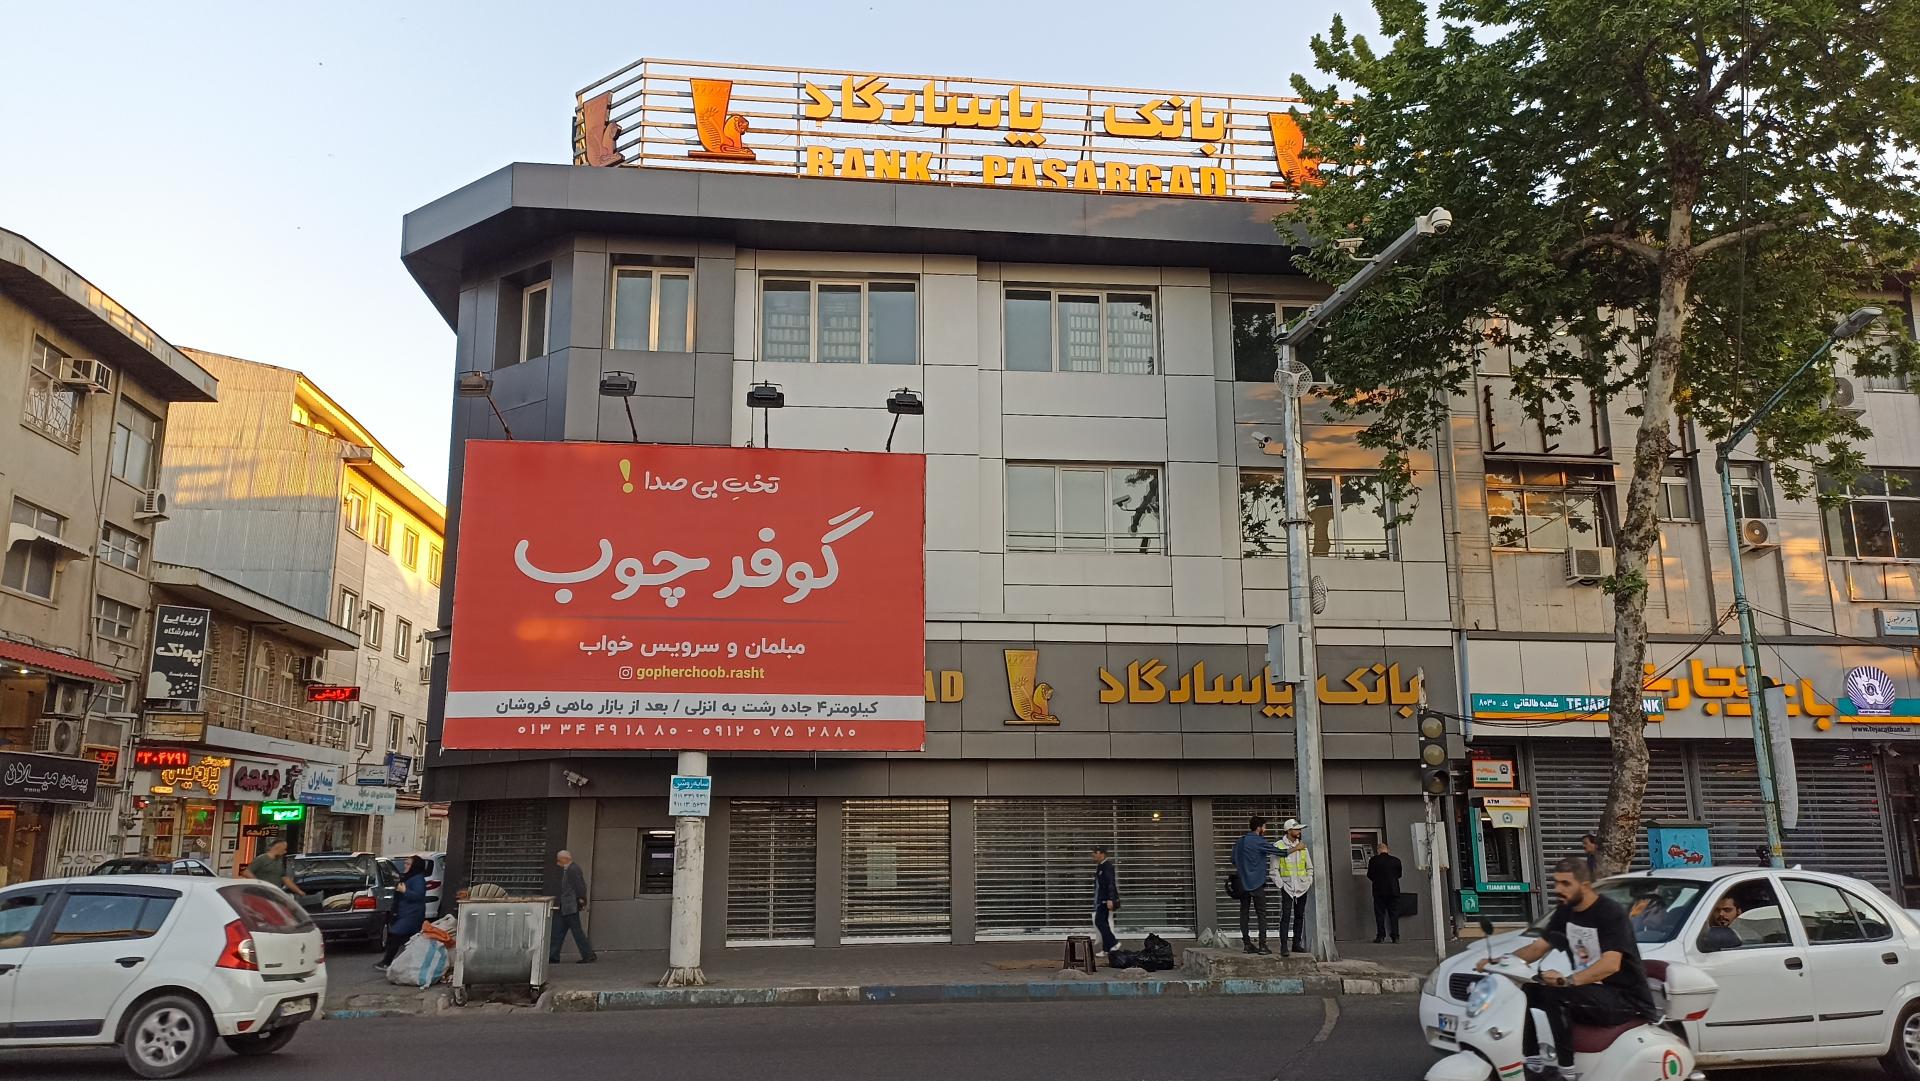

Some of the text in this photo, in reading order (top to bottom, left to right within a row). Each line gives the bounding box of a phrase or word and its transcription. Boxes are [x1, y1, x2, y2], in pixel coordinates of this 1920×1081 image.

[805, 76, 1225, 157] بانک پاسارگاد
[807, 146, 1227, 196] BANK PASARGAD
[644, 471, 688, 491] صدا
[691, 479, 718, 499] بی
[513, 506, 874, 608] گوفر چوب
[156, 643, 203, 667] پونک
[579, 634, 806, 660] مبلمان و سرویس خواب
[636, 666, 765, 681] gopherchoob.rasht
[1100, 658, 1419, 718] بانک پاسارگاد
[495, 696, 551, 714] فروشان
[555, 699, 594, 714] ماهی
[598, 699, 624, 715] بازار
[628, 699, 640, 714] از
[645, 701, 668, 715] بعد
[684, 700, 716, 716] انزلی
[722, 701, 737, 716] به
[742, 701, 776, 716] رشت
[781, 702, 812, 716] جاده
[1513, 697, 1539, 710] طالقانی
[1539, 697, 1559, 710] شعبه
[1565, 697, 1611, 712] TEJAR
[4, 761, 88, 794] پیراهن میلان
[161, 766, 220, 795] پردیس
[308, 770, 333, 790] بیمه ایران
